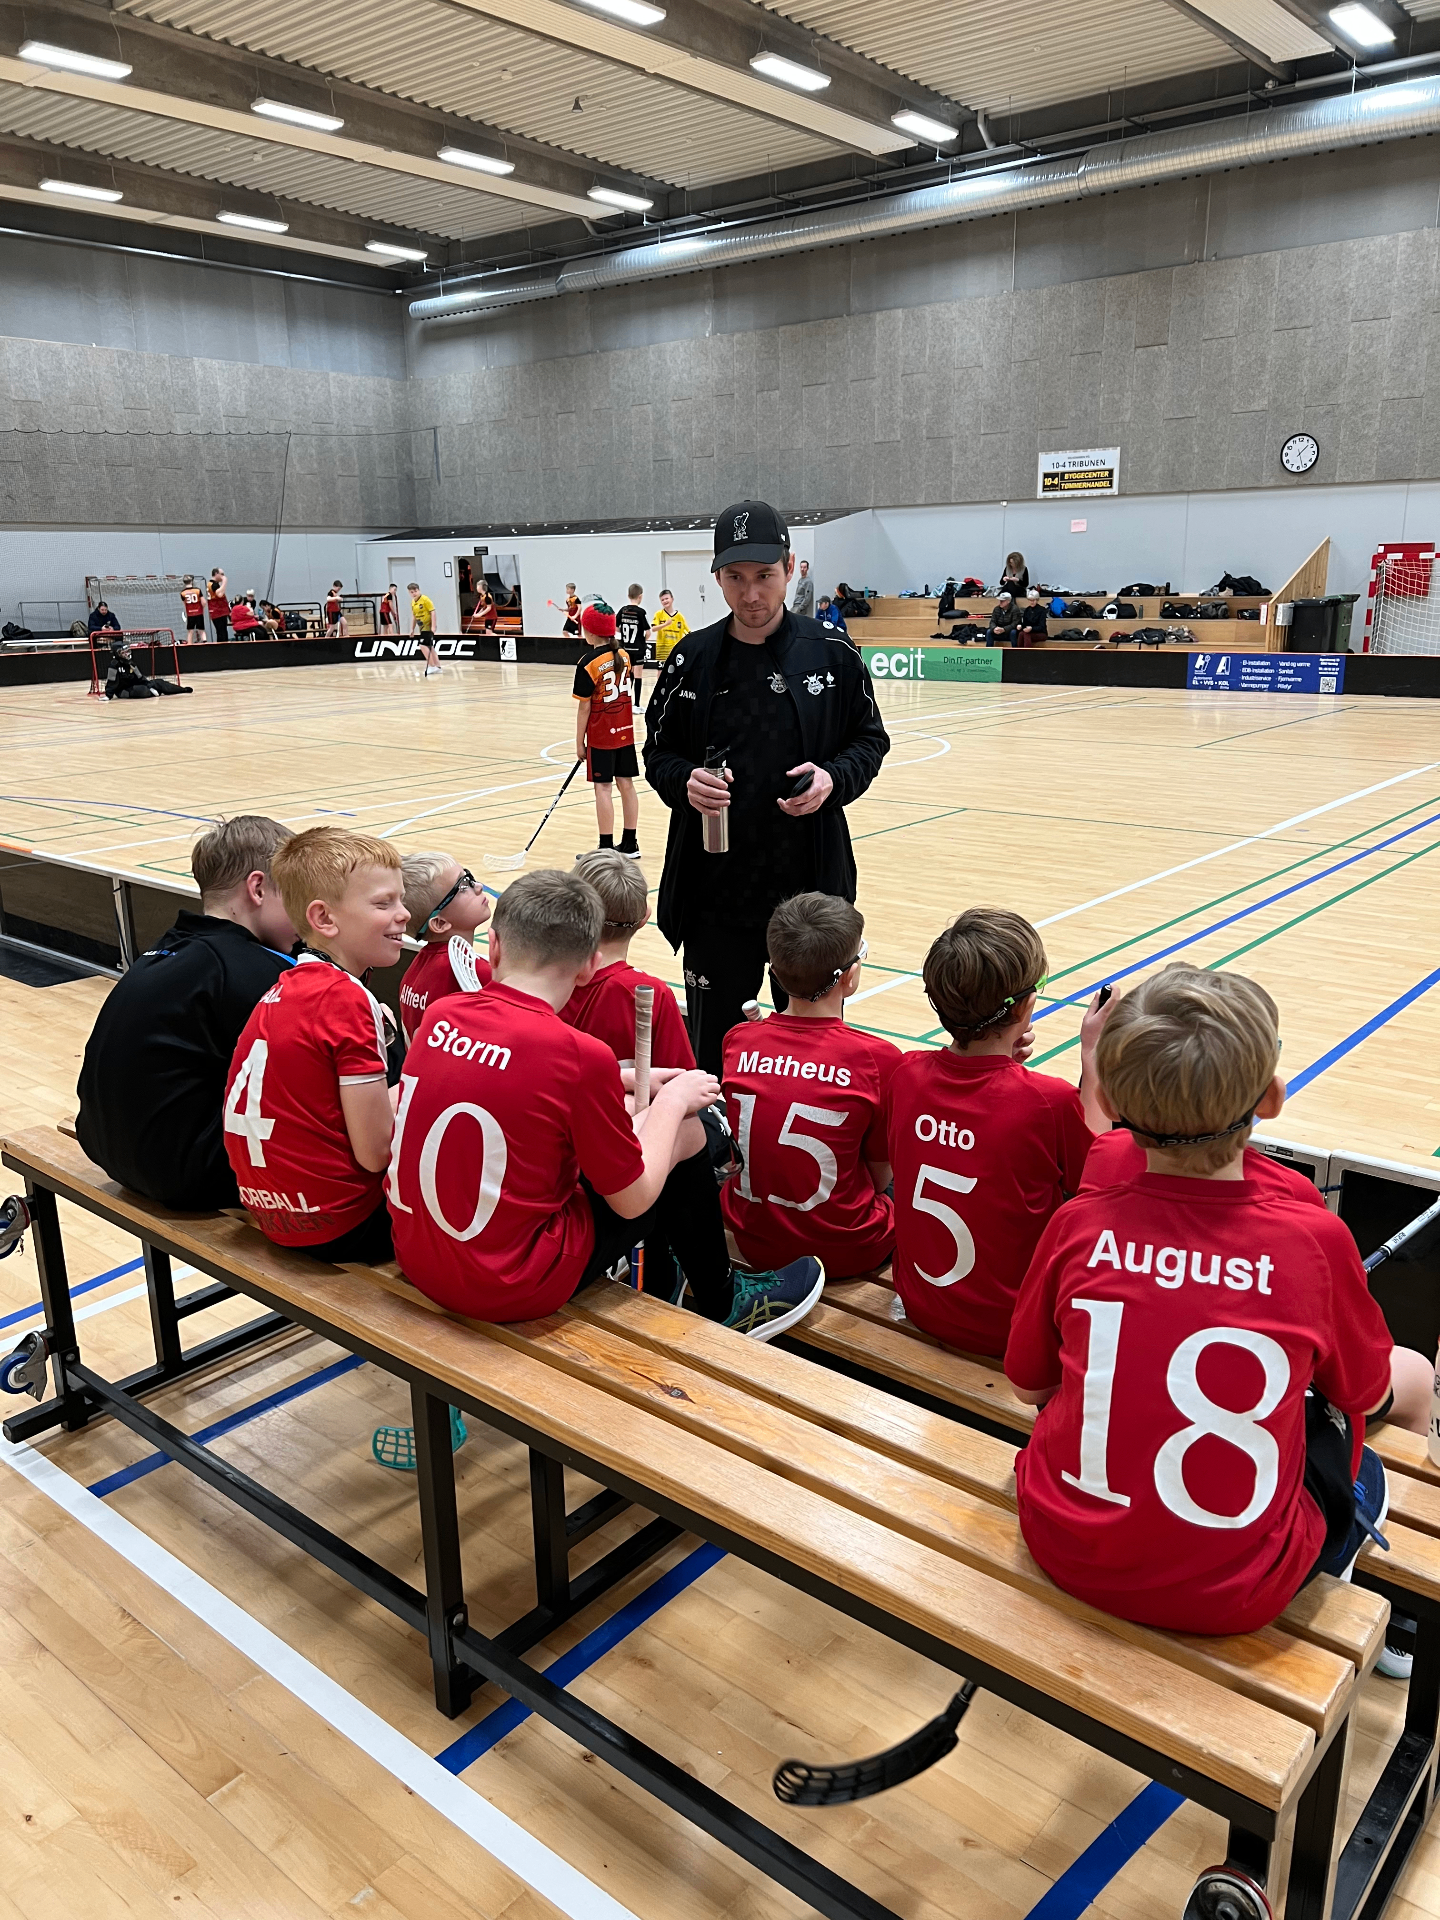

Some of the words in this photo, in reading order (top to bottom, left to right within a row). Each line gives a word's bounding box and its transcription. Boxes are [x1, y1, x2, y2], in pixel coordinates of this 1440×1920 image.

[1044, 477, 1058, 485] 10-4
[1064, 471, 1109, 479] BYGGECENTER
[1068, 459, 1106, 468] TRIBUNEN
[1061, 481, 1110, 489] TØMMERHANDEL
[185, 594, 197, 603] 30
[622, 624, 638, 643] 97
[870, 648, 925, 678] ecit
[943, 656, 955, 664] Din
[957, 656, 992, 666] IT-partner
[603, 666, 632, 703] 34
[400, 984, 429, 1011] Alfred
[427, 1020, 512, 1070] Storm
[736, 1051, 852, 1087] Matheus
[225, 1039, 276, 1168] 4
[915, 1114, 975, 1151] Otto
[386, 1073, 508, 1242] 10
[731, 1092, 850, 1212] 15
[912, 1163, 978, 1287] 5
[1087, 1229, 1275, 1296] August
[1061, 1298, 1291, 1529] 18
